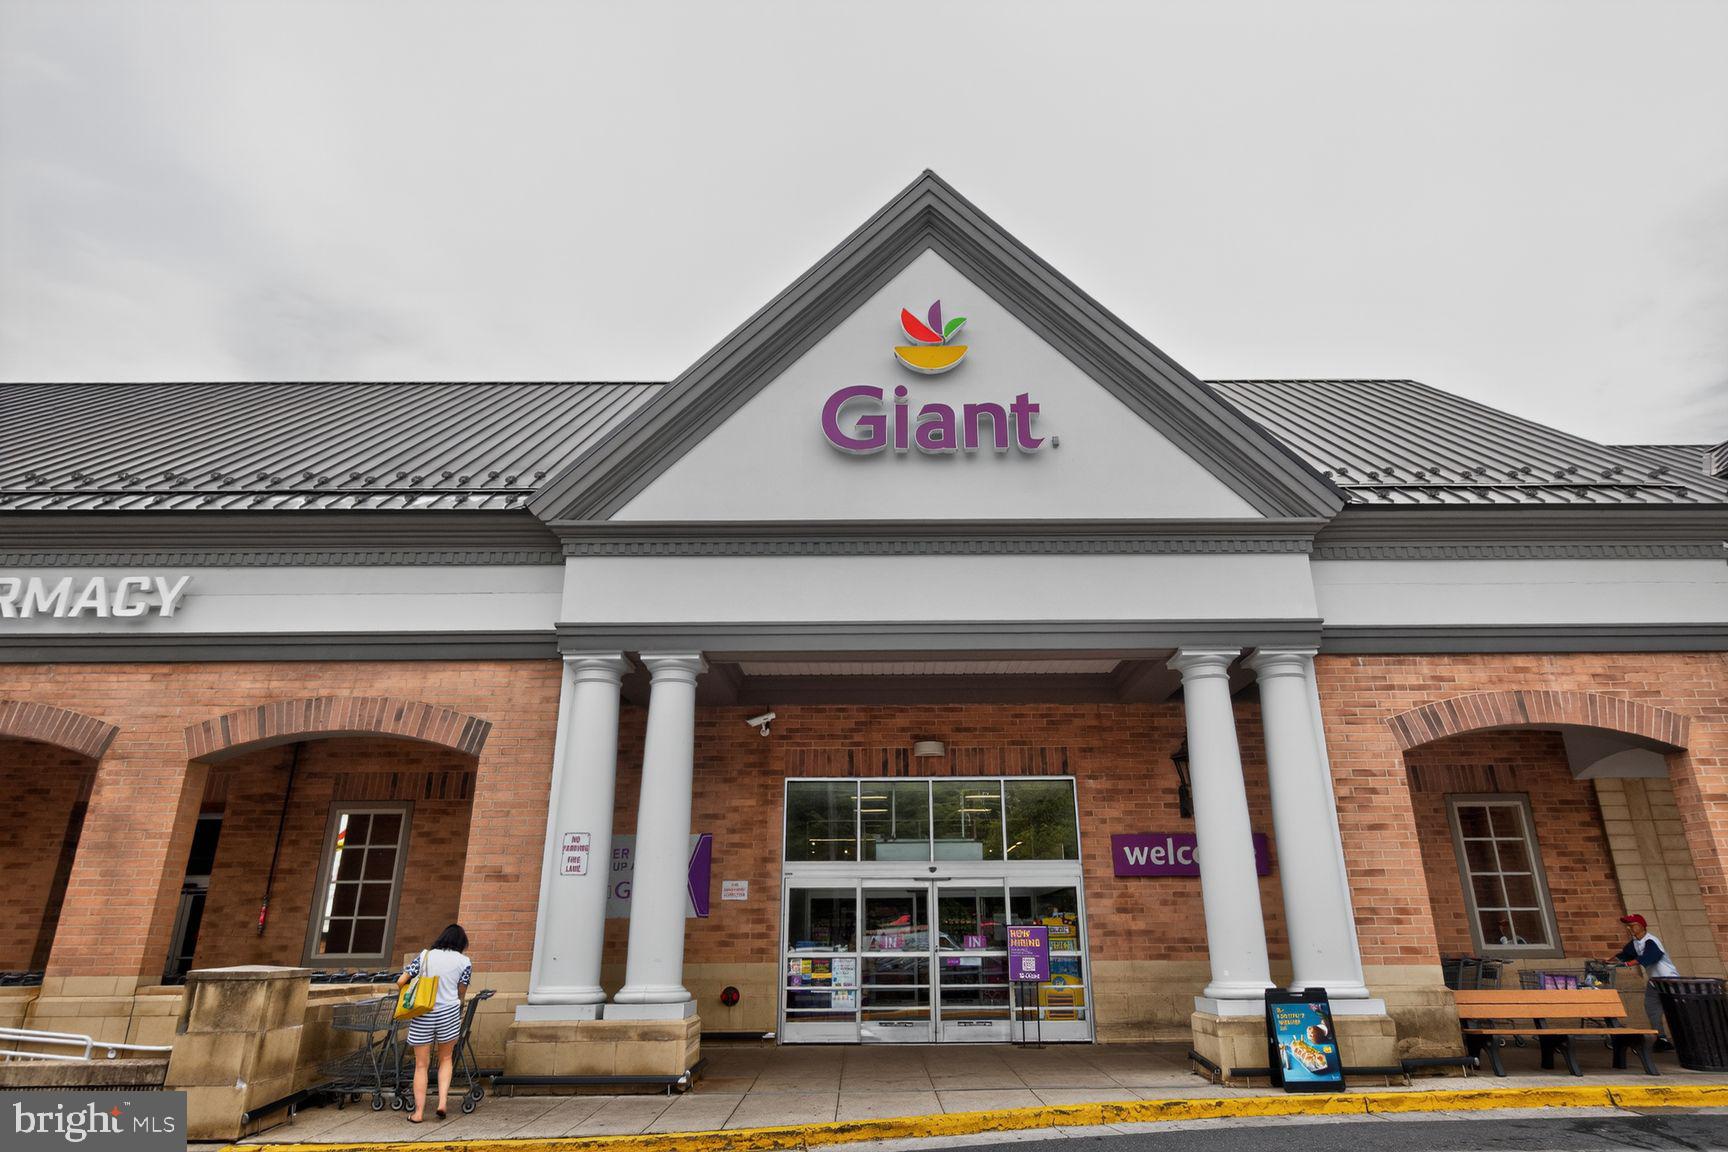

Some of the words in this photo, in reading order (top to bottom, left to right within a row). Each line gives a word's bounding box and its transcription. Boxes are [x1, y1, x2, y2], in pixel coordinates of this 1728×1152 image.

[821, 384, 1046, 454] Giant
[571, 835, 581, 844] NO
[562, 844, 589, 852] PARKING
[567, 856, 581, 864] FIRE
[565, 865, 581, 873] LANE
[968, 936, 980, 947] IN
